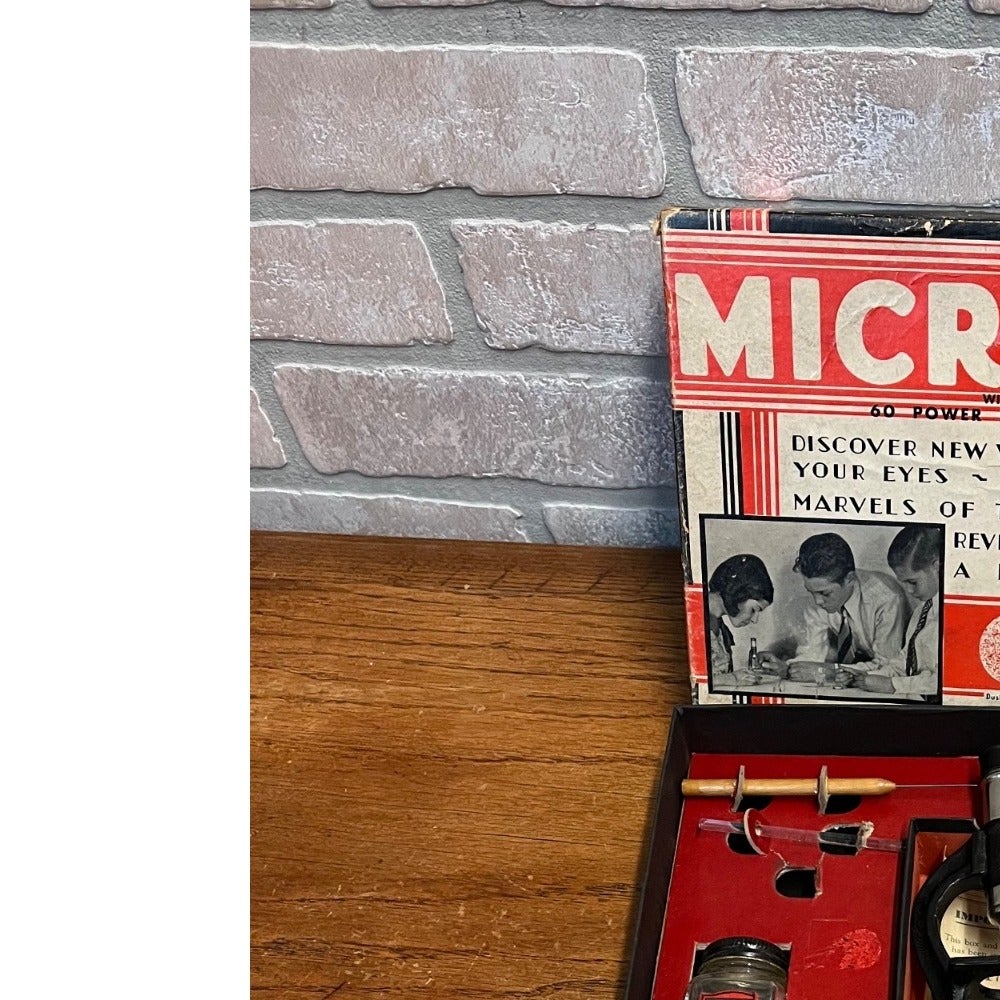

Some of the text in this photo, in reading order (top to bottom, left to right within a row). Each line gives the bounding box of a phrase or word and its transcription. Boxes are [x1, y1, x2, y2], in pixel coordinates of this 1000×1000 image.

[870, 404, 895, 418] 60
[913, 406, 982, 422] POWER
[792, 434, 917, 457] DISCOVER
[931, 441, 987, 460] NEW
[792, 461, 948, 484] YOUR EYES
[793, 494, 916, 516] MARVELS
[939, 501, 975, 519] OF
[953, 562, 971, 579] A
[944, 932, 962, 945] This
[964, 938, 979, 948] box
[982, 942, 998, 950] and
[951, 946, 965, 955] has
